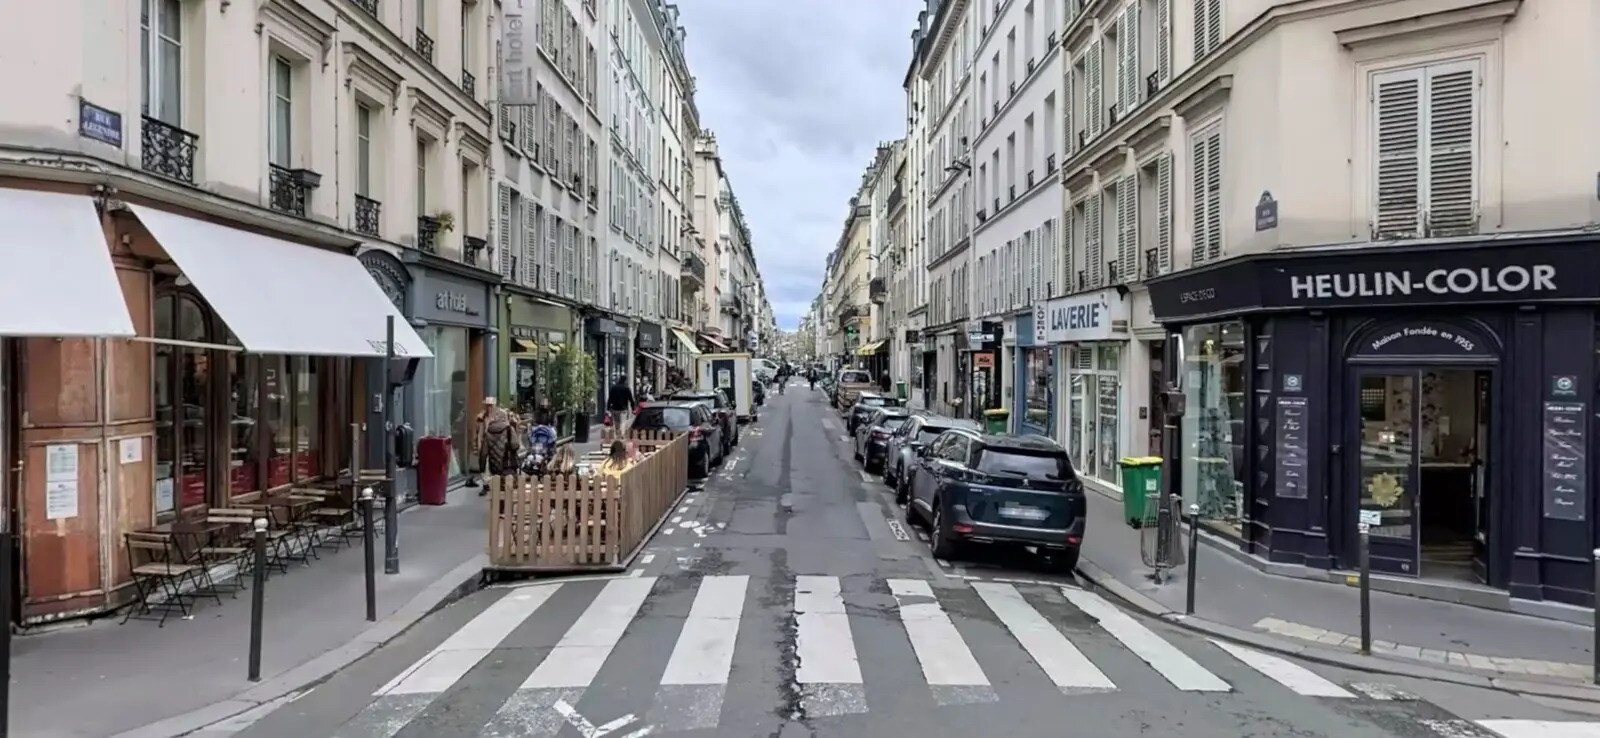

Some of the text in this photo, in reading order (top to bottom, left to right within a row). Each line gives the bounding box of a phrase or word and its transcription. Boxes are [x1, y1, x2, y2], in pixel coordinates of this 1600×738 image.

[505, 14, 523, 63] hotel
[1290, 264, 1558, 299] HEULIN-COLOR
[1051, 302, 1100, 330] LAVERIE
[1371, 326, 1475, 352] Maison Fondée en 1955
